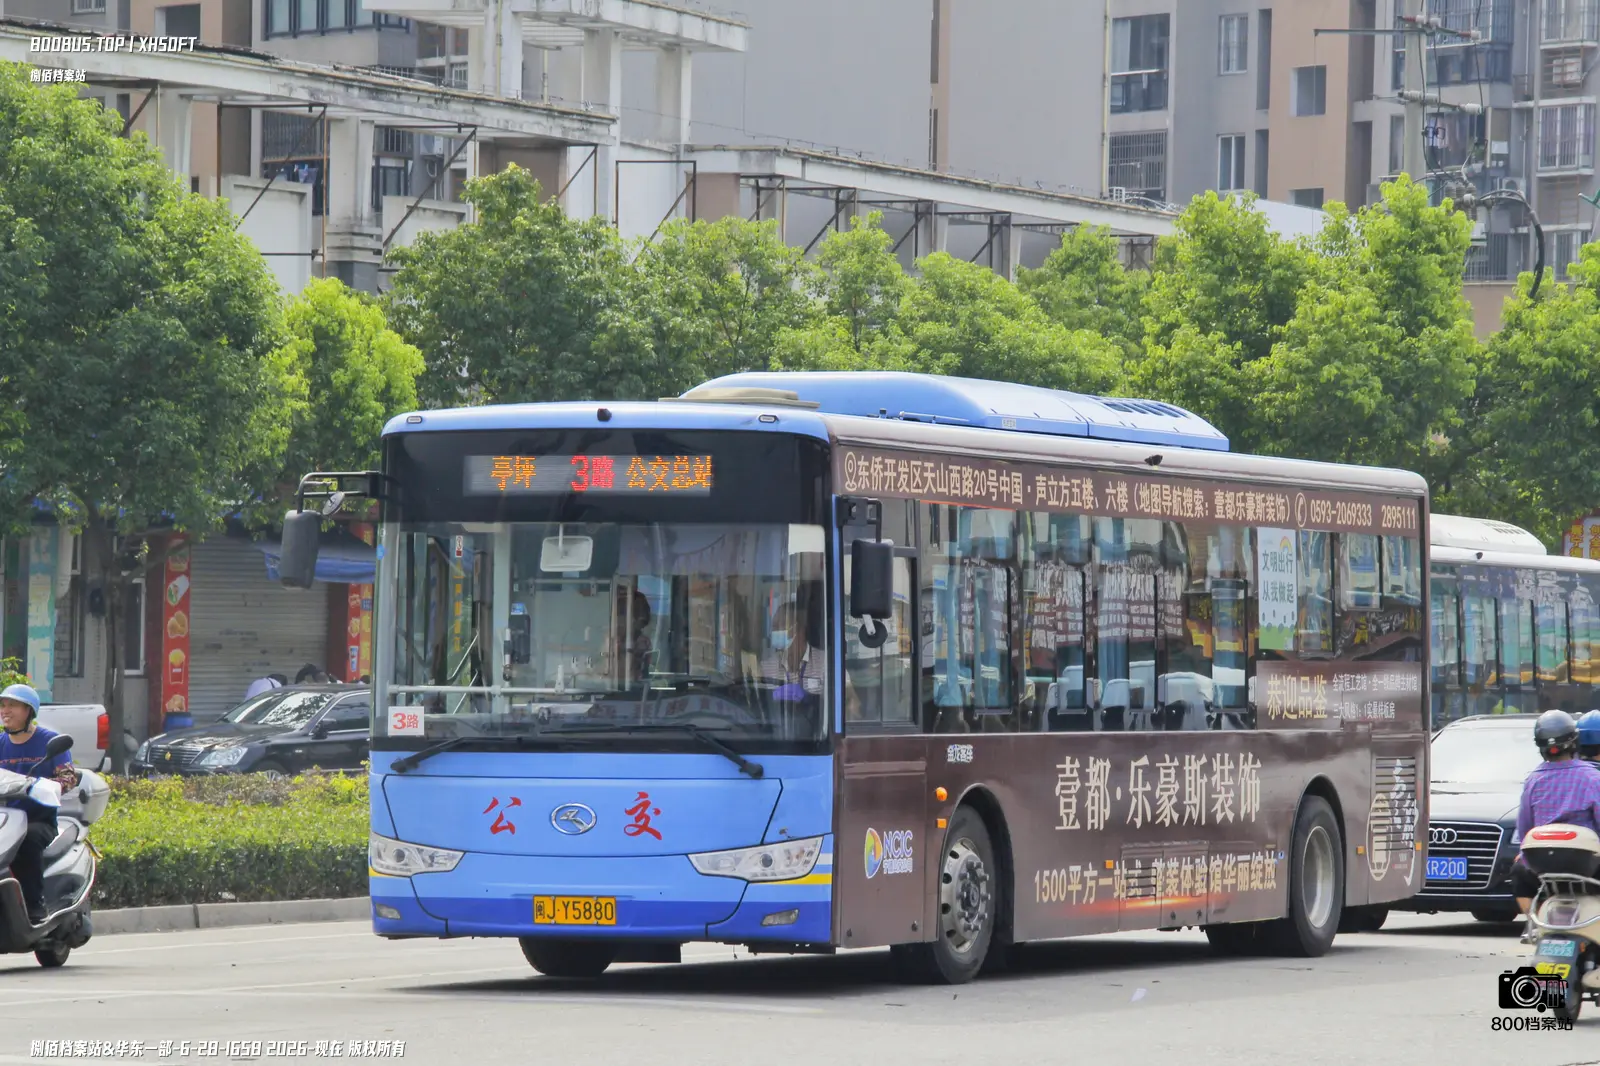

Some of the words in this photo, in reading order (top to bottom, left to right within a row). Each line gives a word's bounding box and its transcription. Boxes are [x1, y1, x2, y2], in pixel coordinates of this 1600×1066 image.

[491, 456, 537, 491] 亭坪
[571, 455, 615, 491] 3路
[626, 455, 713, 491] 公交总站
[1310, 498, 1373, 527] 0593-2069333
[1381, 504, 1417, 530] 2895111
[1262, 549, 1293, 574] 文明出行
[1262, 581, 1294, 604] 从我做起
[1267, 674, 1328, 720] 恭迎品鉴
[392, 712, 419, 730] 3路
[483, 797, 522, 835] 公
[623, 791, 662, 840] 交
[883, 830, 913, 858] NCIC
